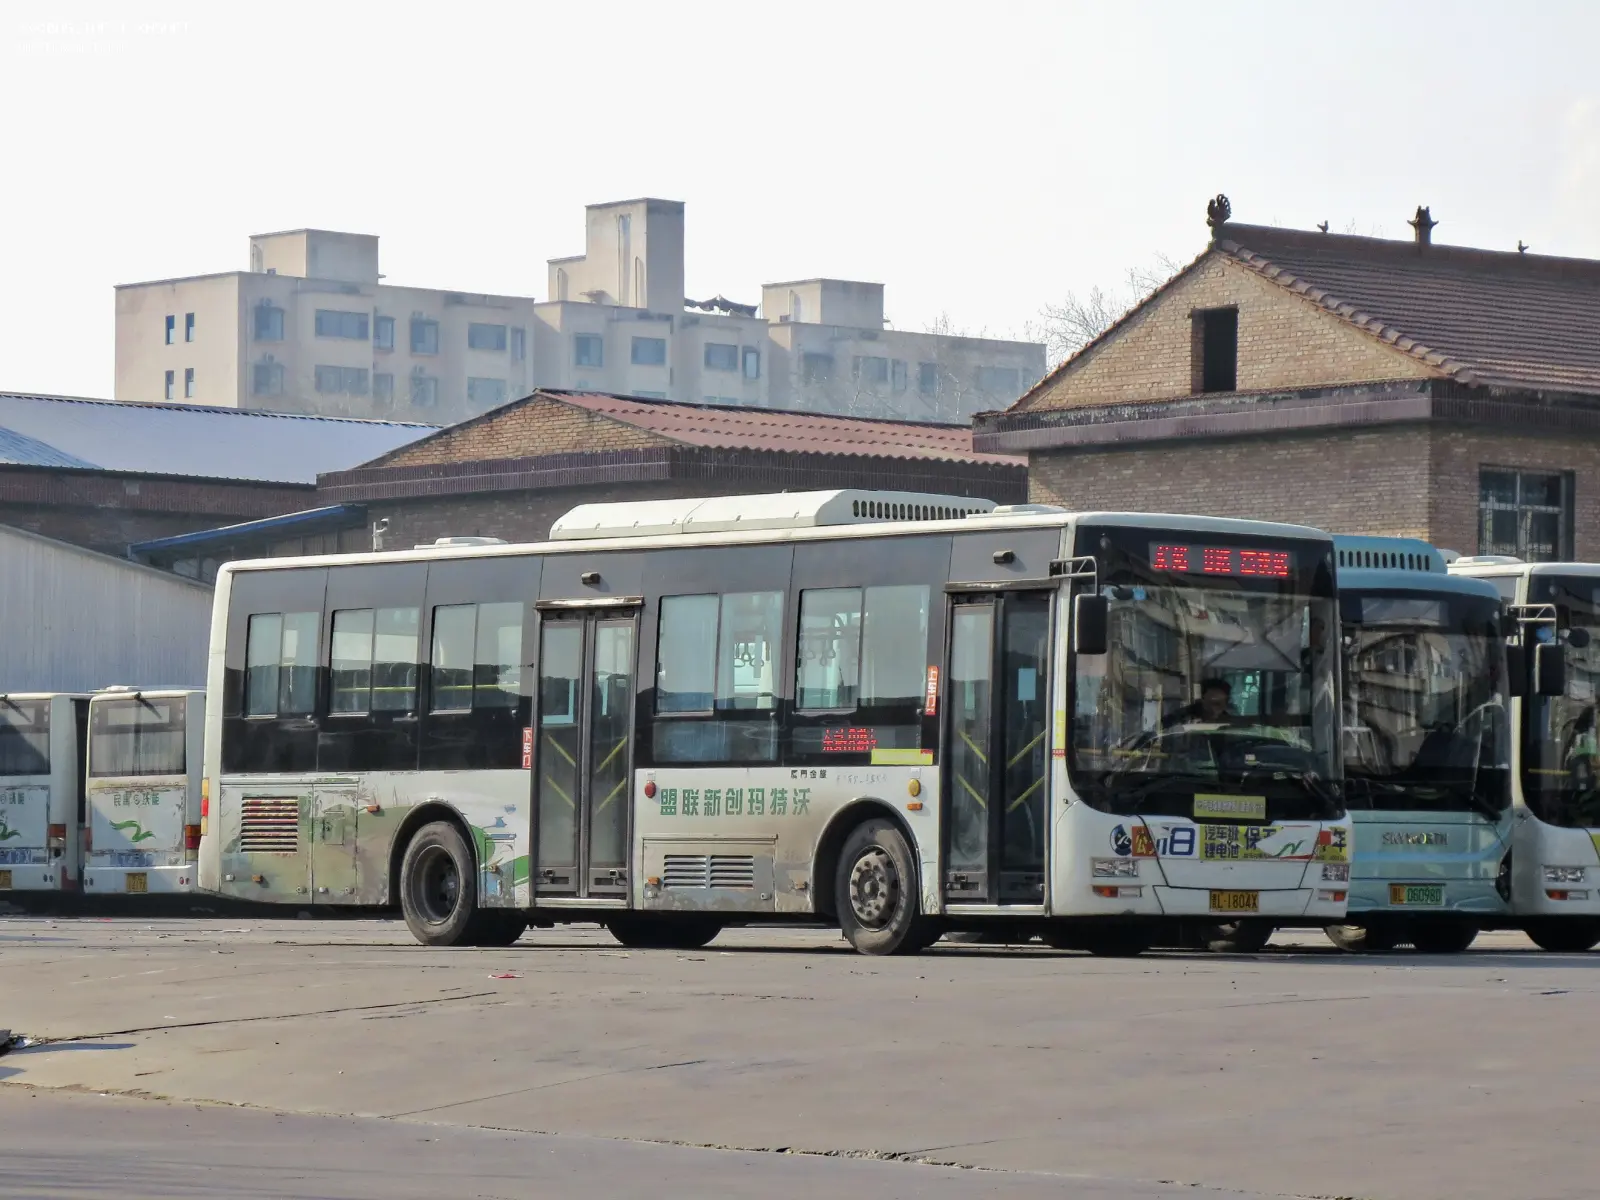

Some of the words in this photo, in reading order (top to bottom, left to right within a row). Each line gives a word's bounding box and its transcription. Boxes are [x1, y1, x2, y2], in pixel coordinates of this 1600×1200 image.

[660, 788, 812, 816] 盟联新创玛特沃
